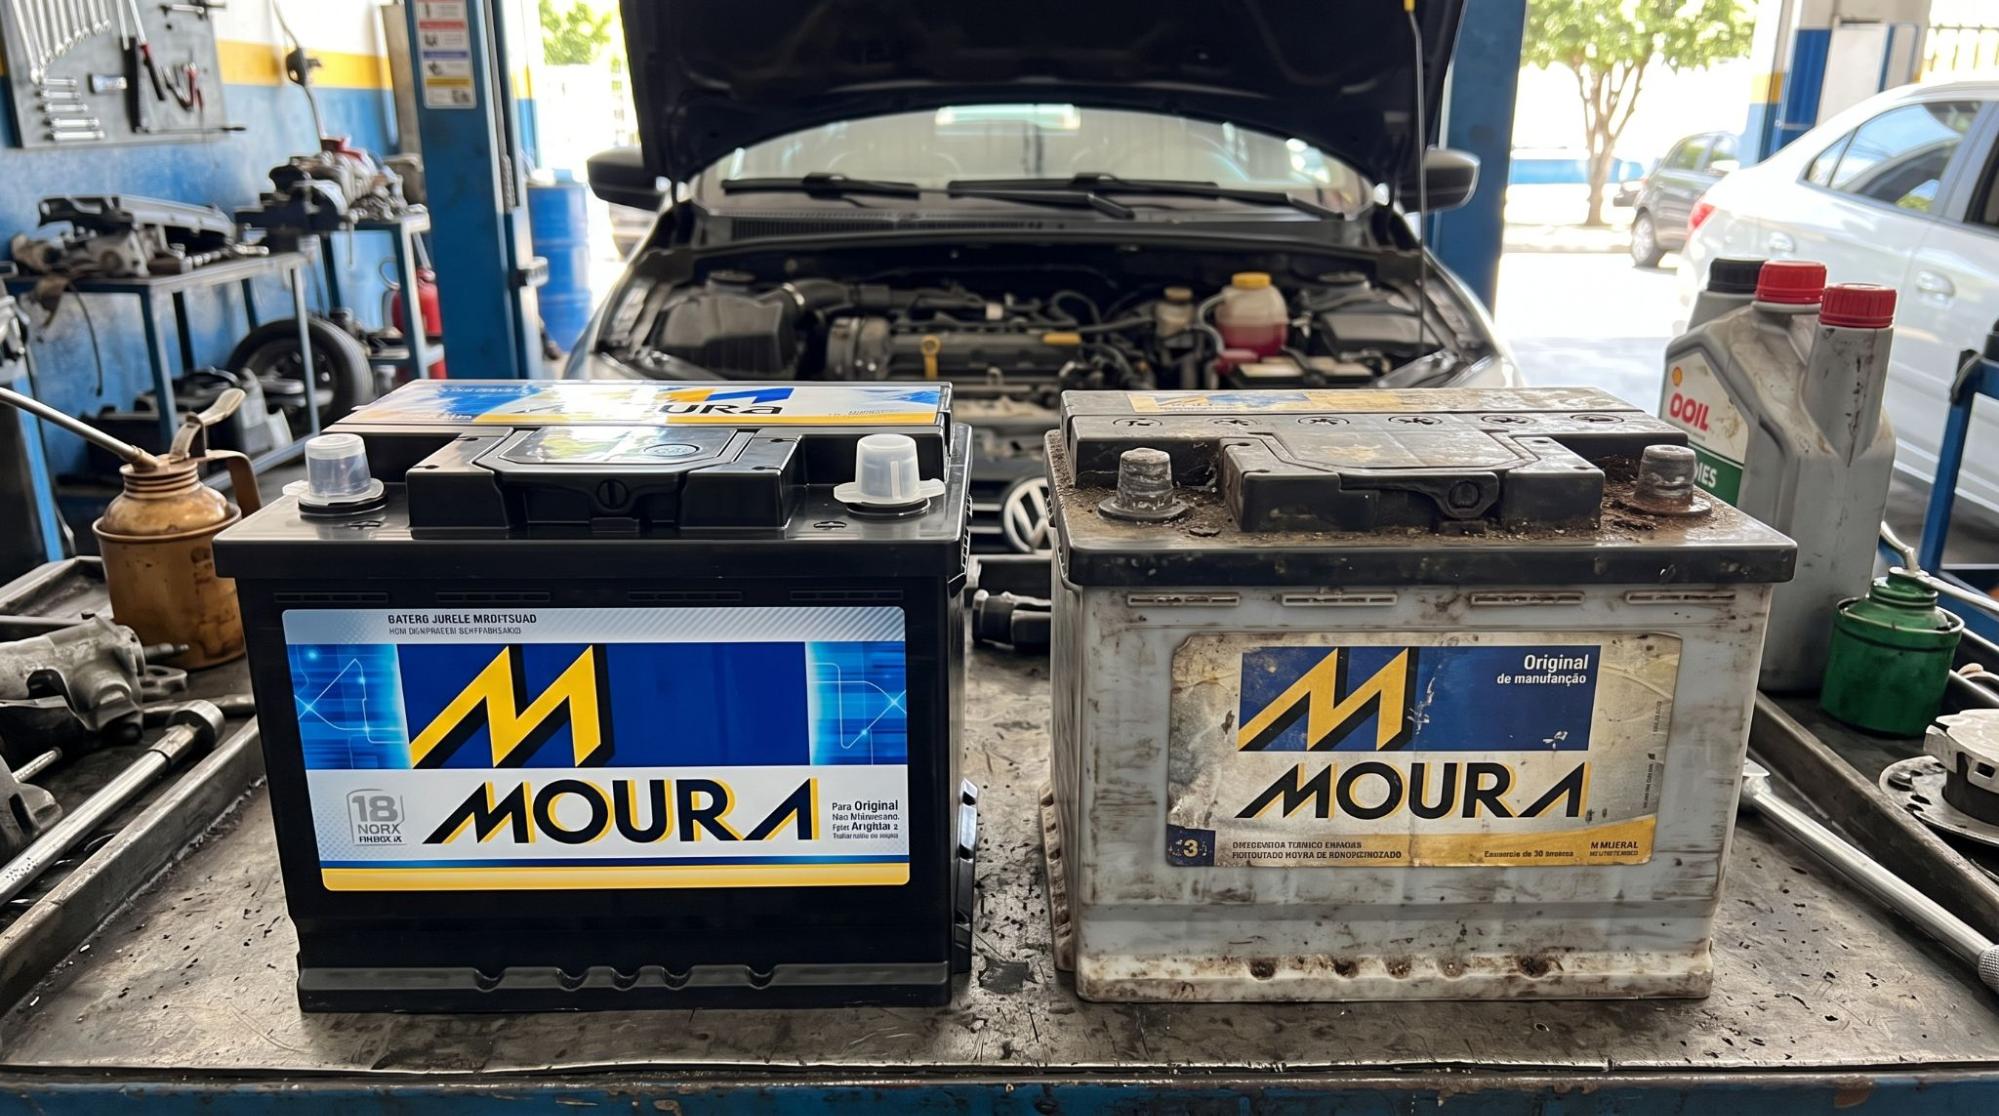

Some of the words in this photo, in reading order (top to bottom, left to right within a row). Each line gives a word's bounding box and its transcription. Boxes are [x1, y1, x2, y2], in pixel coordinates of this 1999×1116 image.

[432, 613, 470, 624] JURELE
[1523, 653, 1589, 673] Original
[1496, 673, 1511, 684] de
[1234, 761, 1592, 820] MOURA
[352, 795, 399, 822] 18
[422, 778, 820, 845] MOURA
[832, 802, 852, 811] Para
[854, 799, 899, 813] Original
[357, 824, 402, 835] NORX
[1183, 839, 1199, 858] 3
